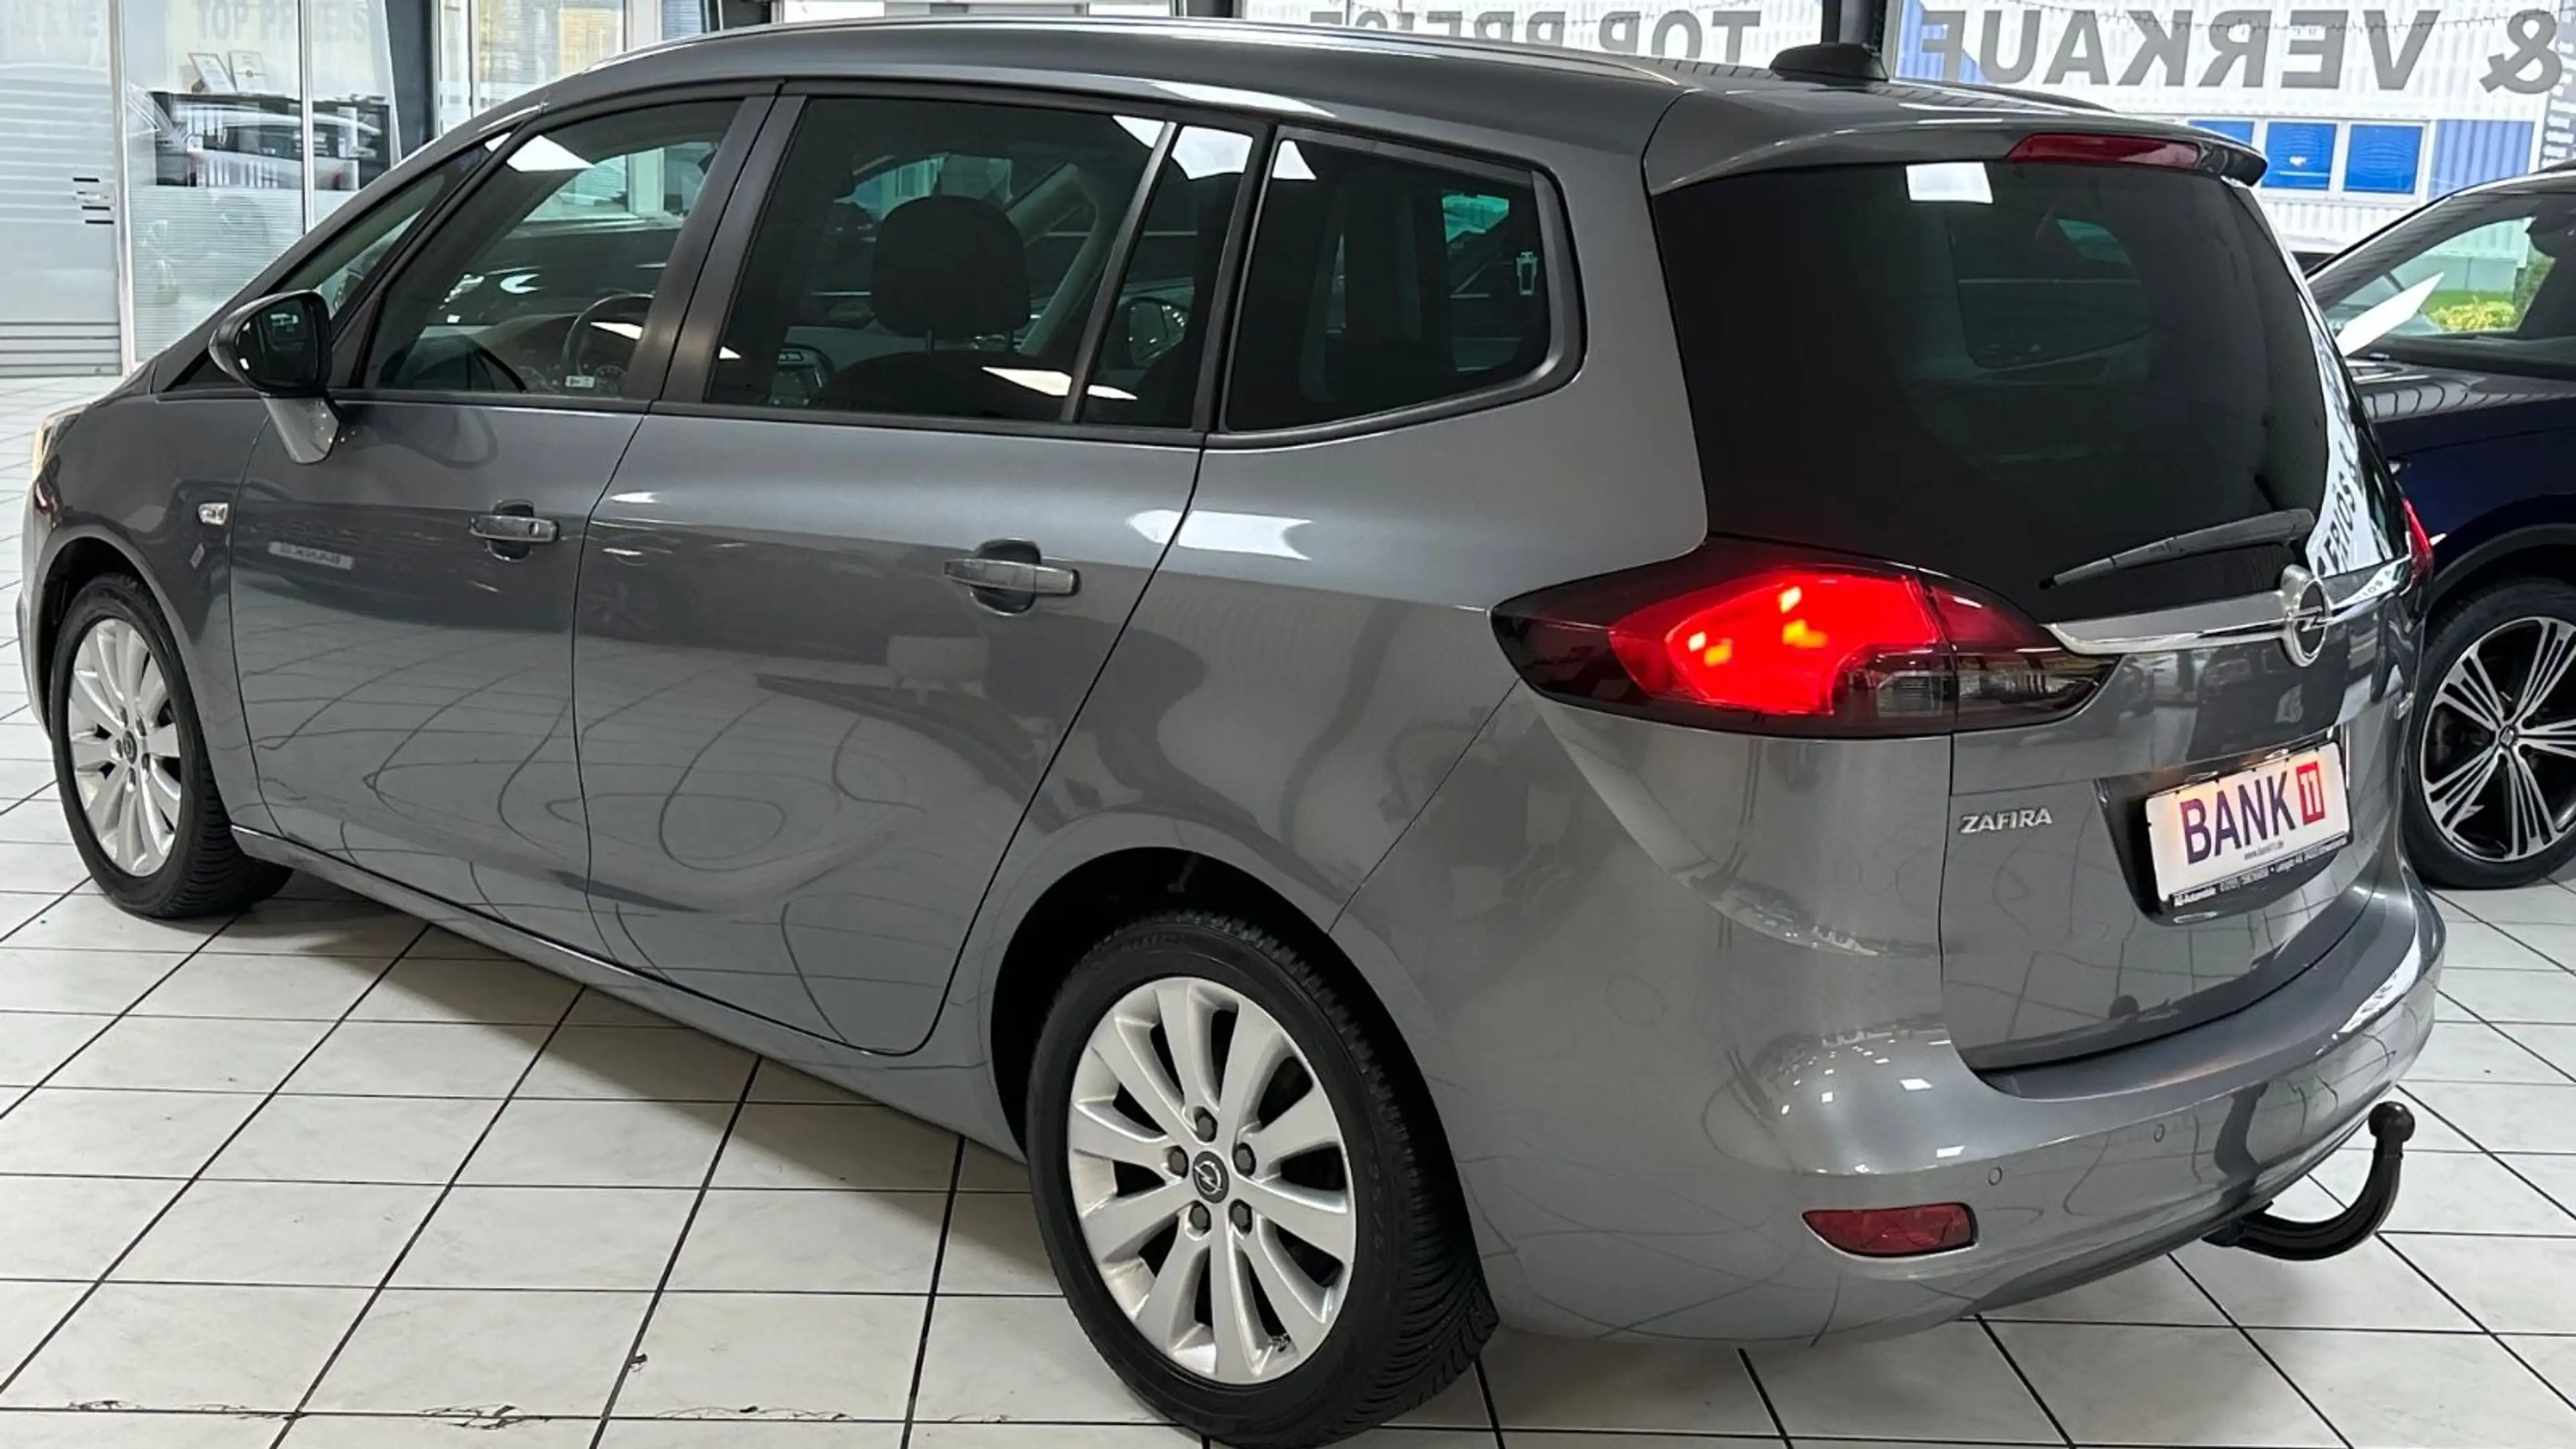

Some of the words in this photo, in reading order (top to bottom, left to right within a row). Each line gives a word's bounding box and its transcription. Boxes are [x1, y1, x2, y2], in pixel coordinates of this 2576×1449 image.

[1960, 808, 2053, 834] ZAFIRA
[2180, 771, 2296, 865] BANK
[2299, 766, 2324, 820] 11
